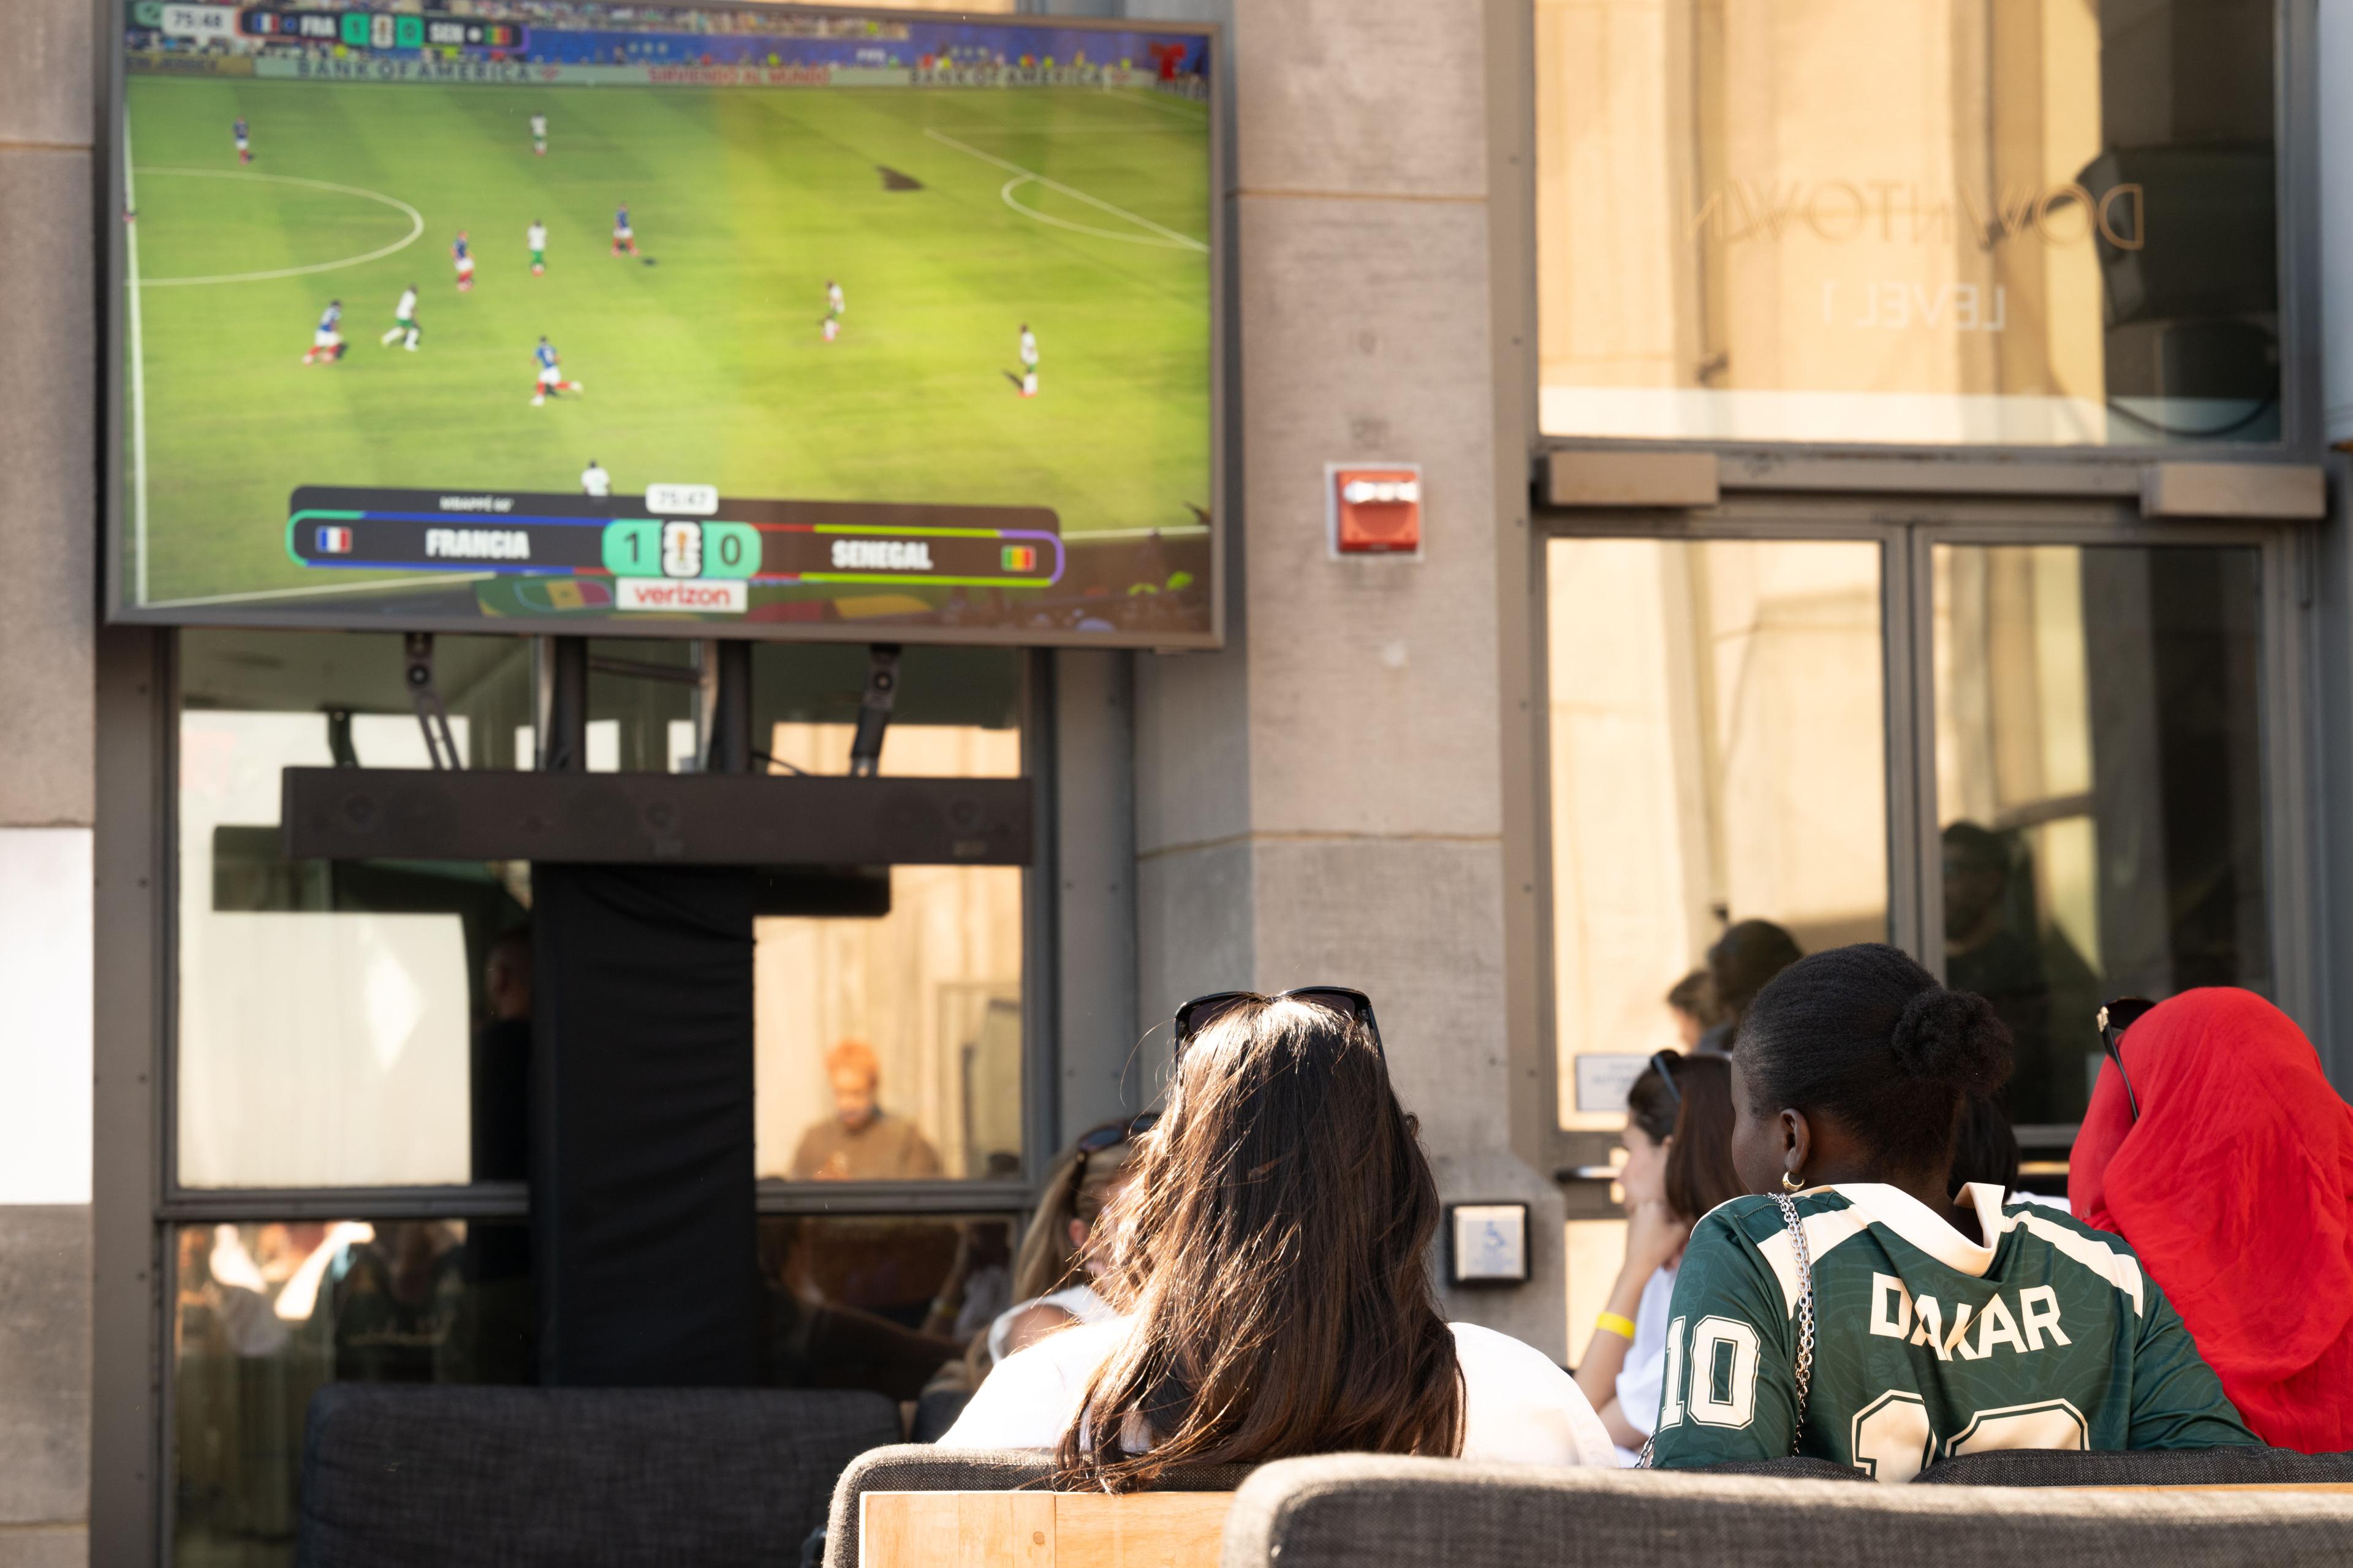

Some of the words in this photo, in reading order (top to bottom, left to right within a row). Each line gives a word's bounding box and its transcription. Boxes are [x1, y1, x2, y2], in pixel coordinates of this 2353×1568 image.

[300, 16, 336, 37] FRA
[430, 22, 464, 43] SEN
[298, 62, 370, 78] BANK
[378, 62, 409, 78] OF
[415, 63, 531, 80] AMERICA
[425, 528, 531, 559] FRANCIA
[623, 531, 639, 564] 1
[720, 534, 742, 566] 0
[832, 539, 933, 570] SENEGAL
[634, 579, 731, 605] verizon
[1870, 1271, 2072, 1362] DAKAR
[1659, 1314, 1761, 1433] 10
